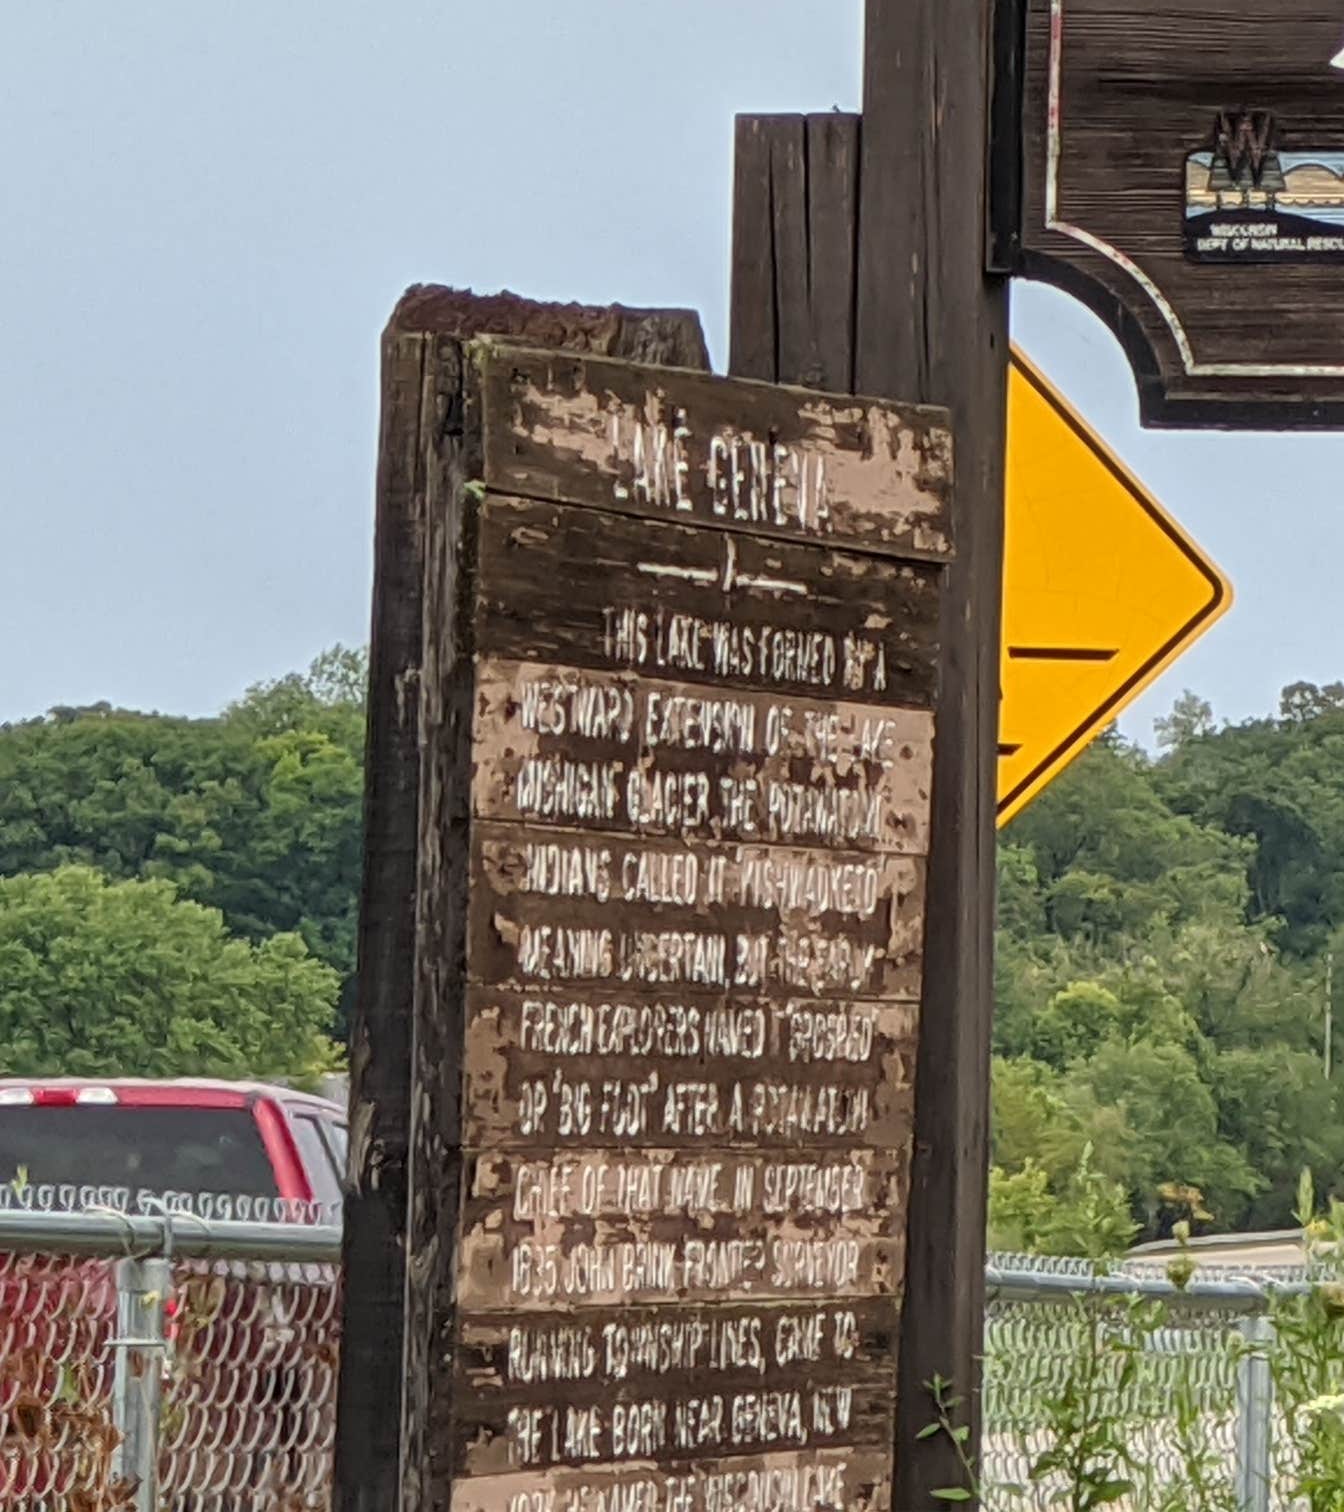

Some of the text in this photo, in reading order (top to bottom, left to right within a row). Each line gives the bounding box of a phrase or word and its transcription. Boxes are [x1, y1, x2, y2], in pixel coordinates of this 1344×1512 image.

[1232, 237, 1250, 251] OF
[1251, 237, 1306, 251] NATURAL
[603, 606, 647, 665] THIS
[657, 607, 704, 670] LAKE
[713, 621, 754, 677] WAS
[758, 624, 835, 687] FORMED
[873, 641, 886, 692] A
[521, 681, 634, 744] WESTWARD
[645, 690, 755, 754] EXTENSION
[766, 704, 793, 757] OF
[804, 709, 841, 764] THE
[517, 759, 619, 820] MICHIGAN
[627, 769, 710, 827] GLACIER
[719, 777, 758, 831] THE
[525, 843, 612, 903] INDIANS
[621, 851, 699, 905] CALLED
[708, 854, 727, 904] IT
[519, 925, 612, 980] MEANING
[735, 933, 771, 986] BUT
[521, 1000, 593, 1055] FRENCH
[598, 1001, 700, 1056] EXPLORERS
[704, 1007, 765, 1059] NAMED
[519, 1080, 547, 1135] OR
[663, 1082, 720, 1136] AFTER
[729, 1080, 743, 1134] A
[582, 1163, 610, 1216] OF
[618, 1163, 664, 1215] THAT
[734, 1163, 755, 1213] IN
[763, 1162, 867, 1216] SEPTEMBER
[512, 1244, 558, 1297] 1835
[565, 1242, 615, 1296] JOHN
[507, 1324, 596, 1384] RUNNING
[602, 1320, 702, 1380] TOWNSHIP
[774, 1312, 827, 1368] CAME
[833, 1310, 862, 1360] TO
[611, 1399, 668, 1457] BORN
[674, 1394, 724, 1449] NEAR
[812, 1384, 855, 1436] NEW
